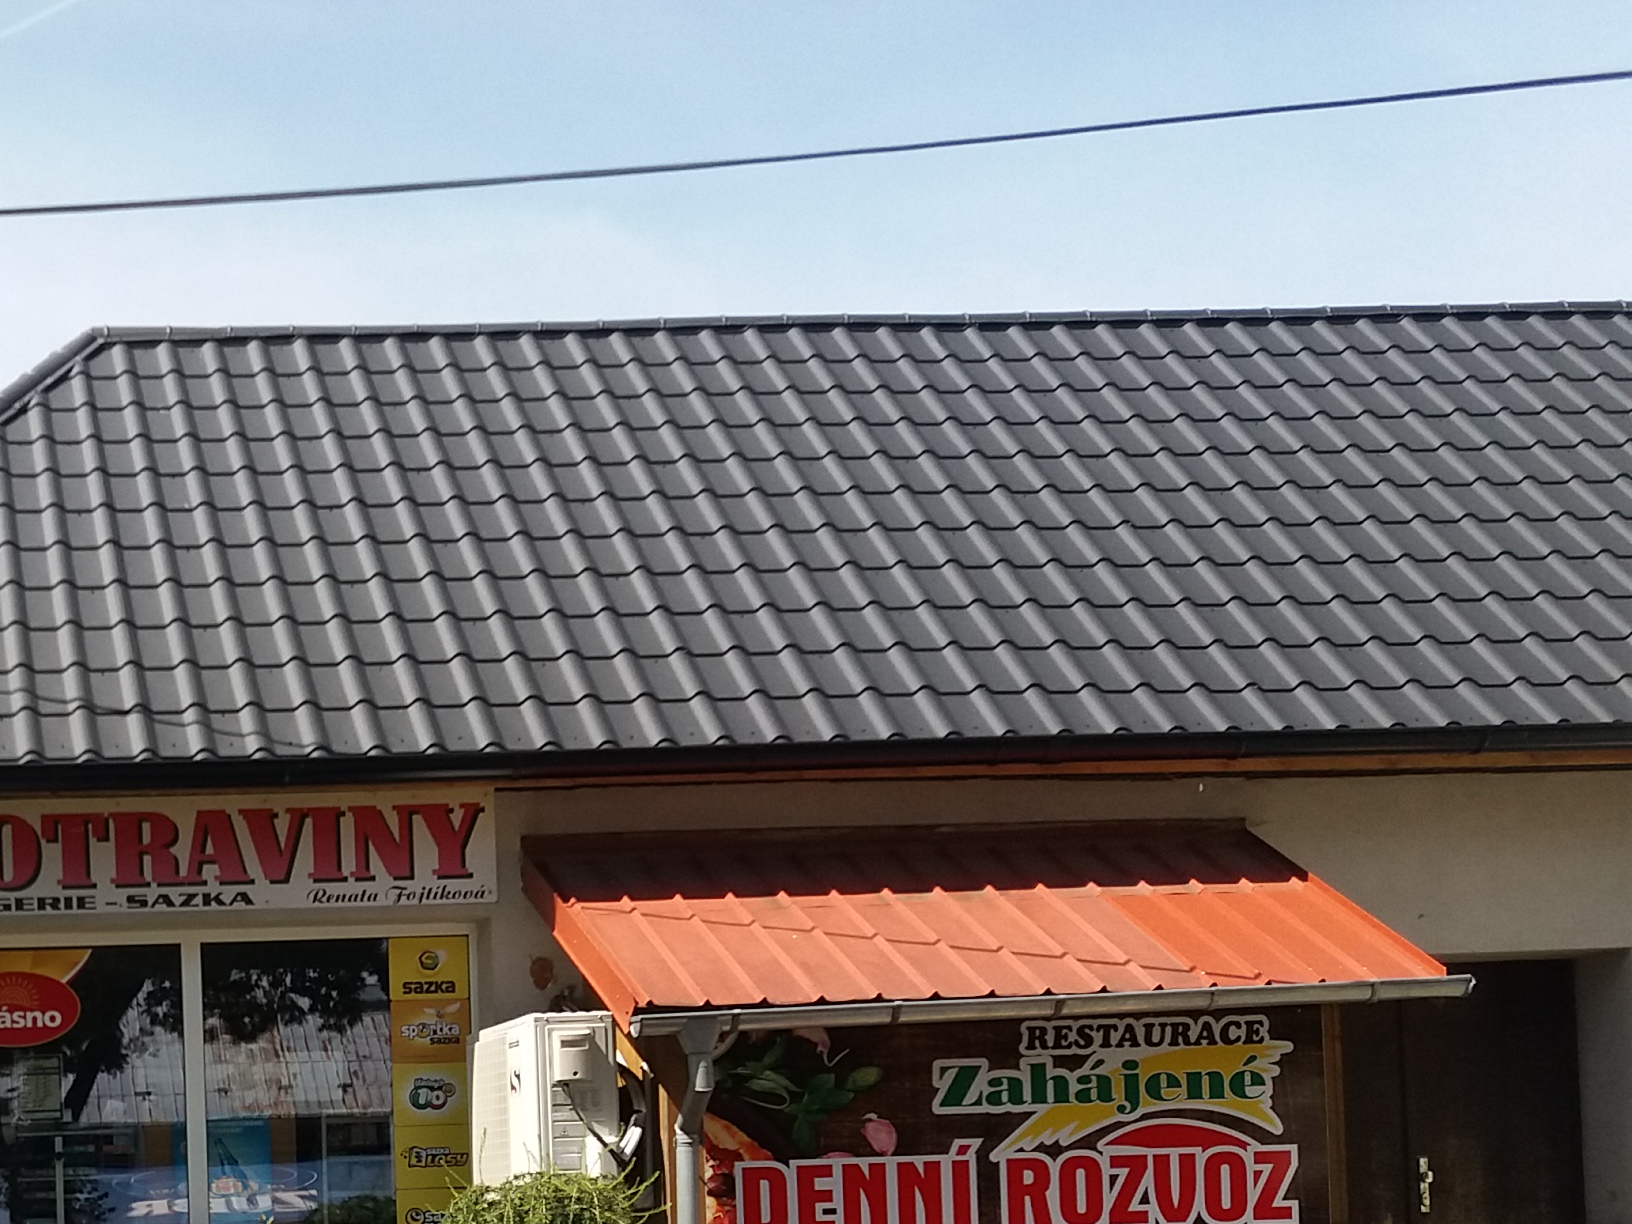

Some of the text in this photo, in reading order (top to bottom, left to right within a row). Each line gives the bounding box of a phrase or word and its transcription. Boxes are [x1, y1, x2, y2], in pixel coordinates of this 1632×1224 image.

[126, 892, 255, 910] SAZKA
[307, 885, 486, 904] Renata Fojtíková
[401, 1021, 461, 1040] sportka
[1024, 1018, 1266, 1052] RESTAURACE
[939, 1055, 1267, 1114] Zahájené
